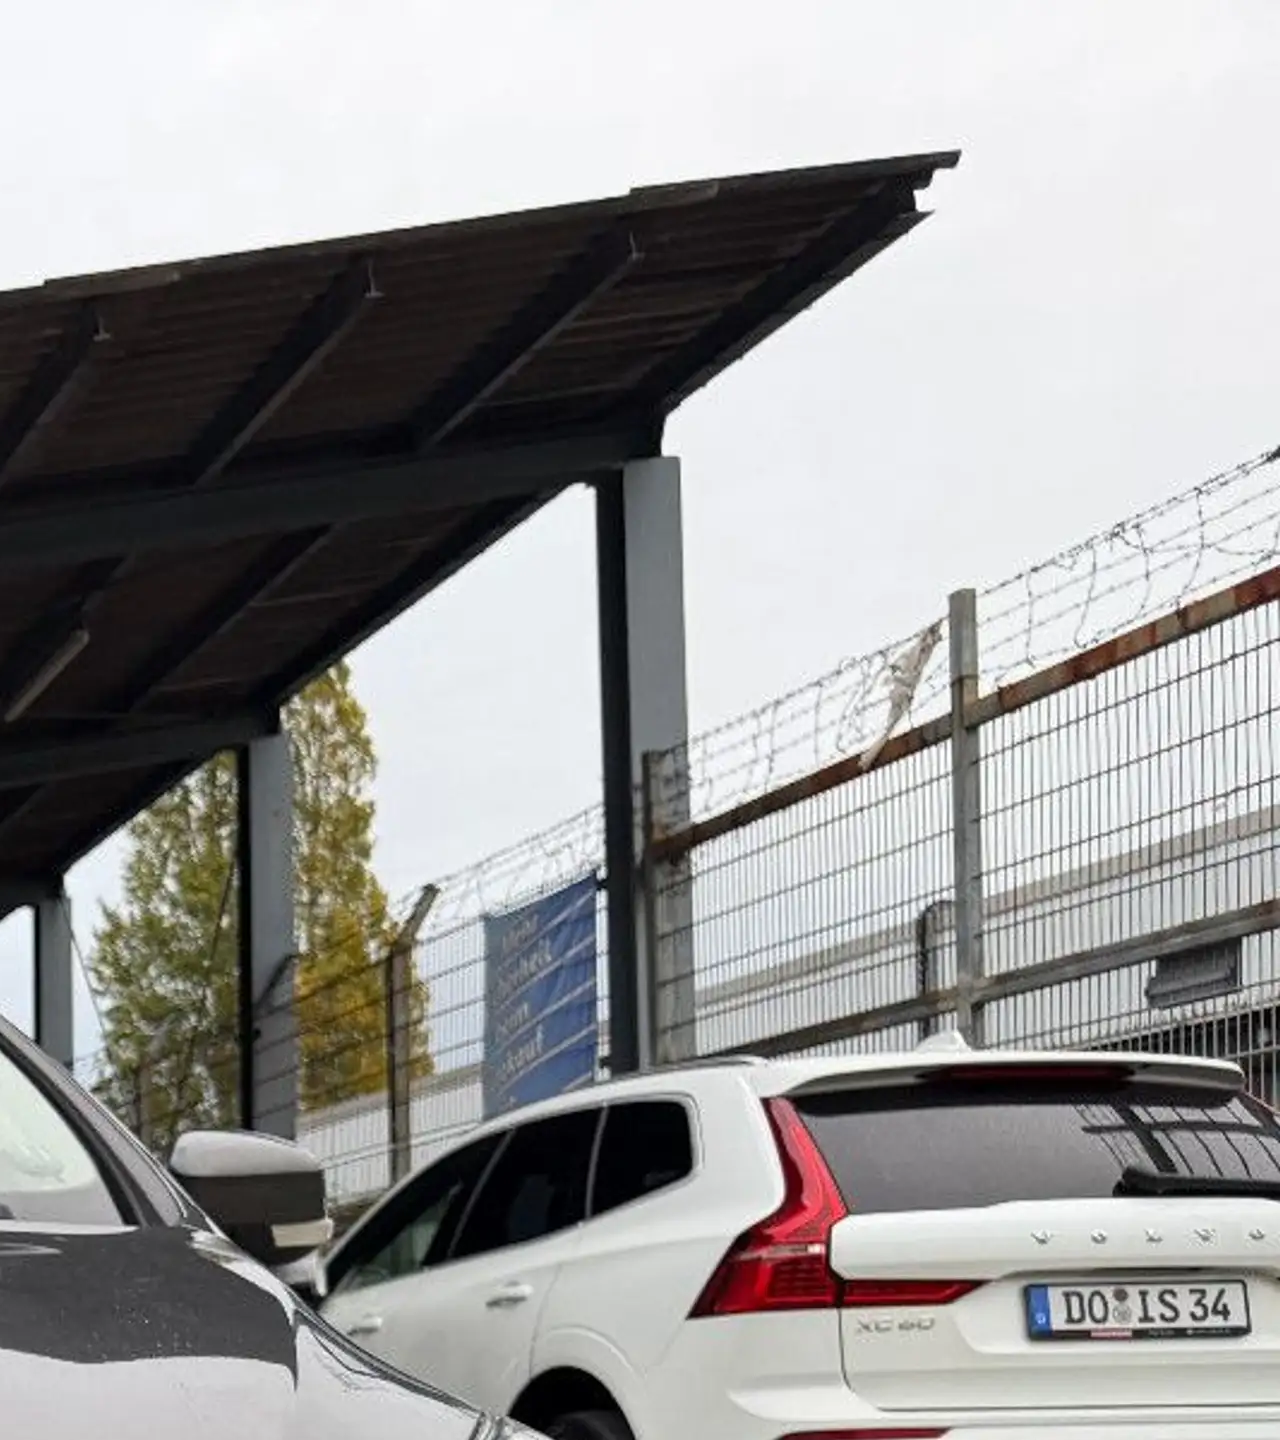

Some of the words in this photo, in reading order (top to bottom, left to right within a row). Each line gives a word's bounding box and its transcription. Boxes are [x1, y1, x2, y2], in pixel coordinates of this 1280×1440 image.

[1062, 1289, 1109, 1324] DO
[1139, 1288, 1180, 1323] IS
[1189, 1287, 1231, 1321] 34
